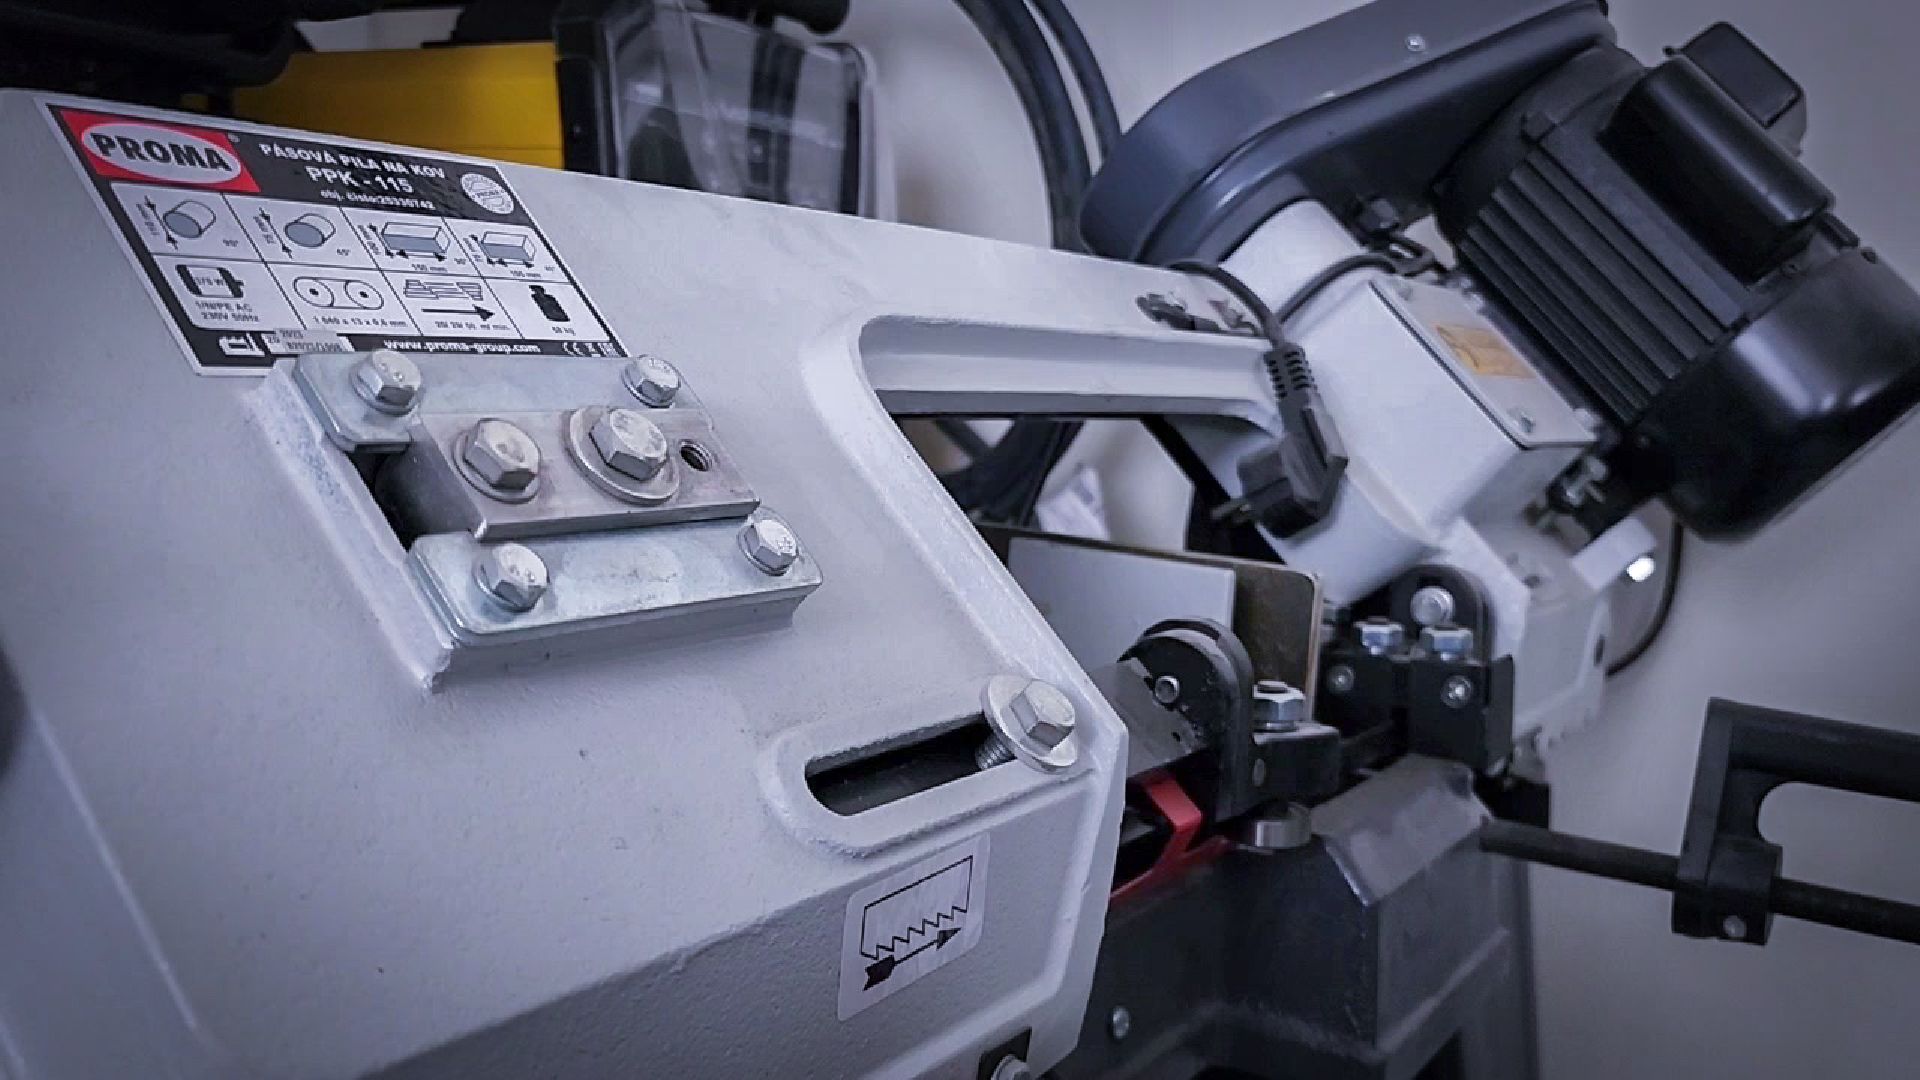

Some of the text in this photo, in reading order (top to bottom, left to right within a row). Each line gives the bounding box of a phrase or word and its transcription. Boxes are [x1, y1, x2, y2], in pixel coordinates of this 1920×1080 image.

[90, 132, 232, 172] PROMA
[258, 141, 445, 179] PÁSOVÁ PILA NA KOV
[304, 165, 360, 187] PPK
[374, 174, 415, 193] 115
[383, 339, 542, 355] www.proma-group.com
